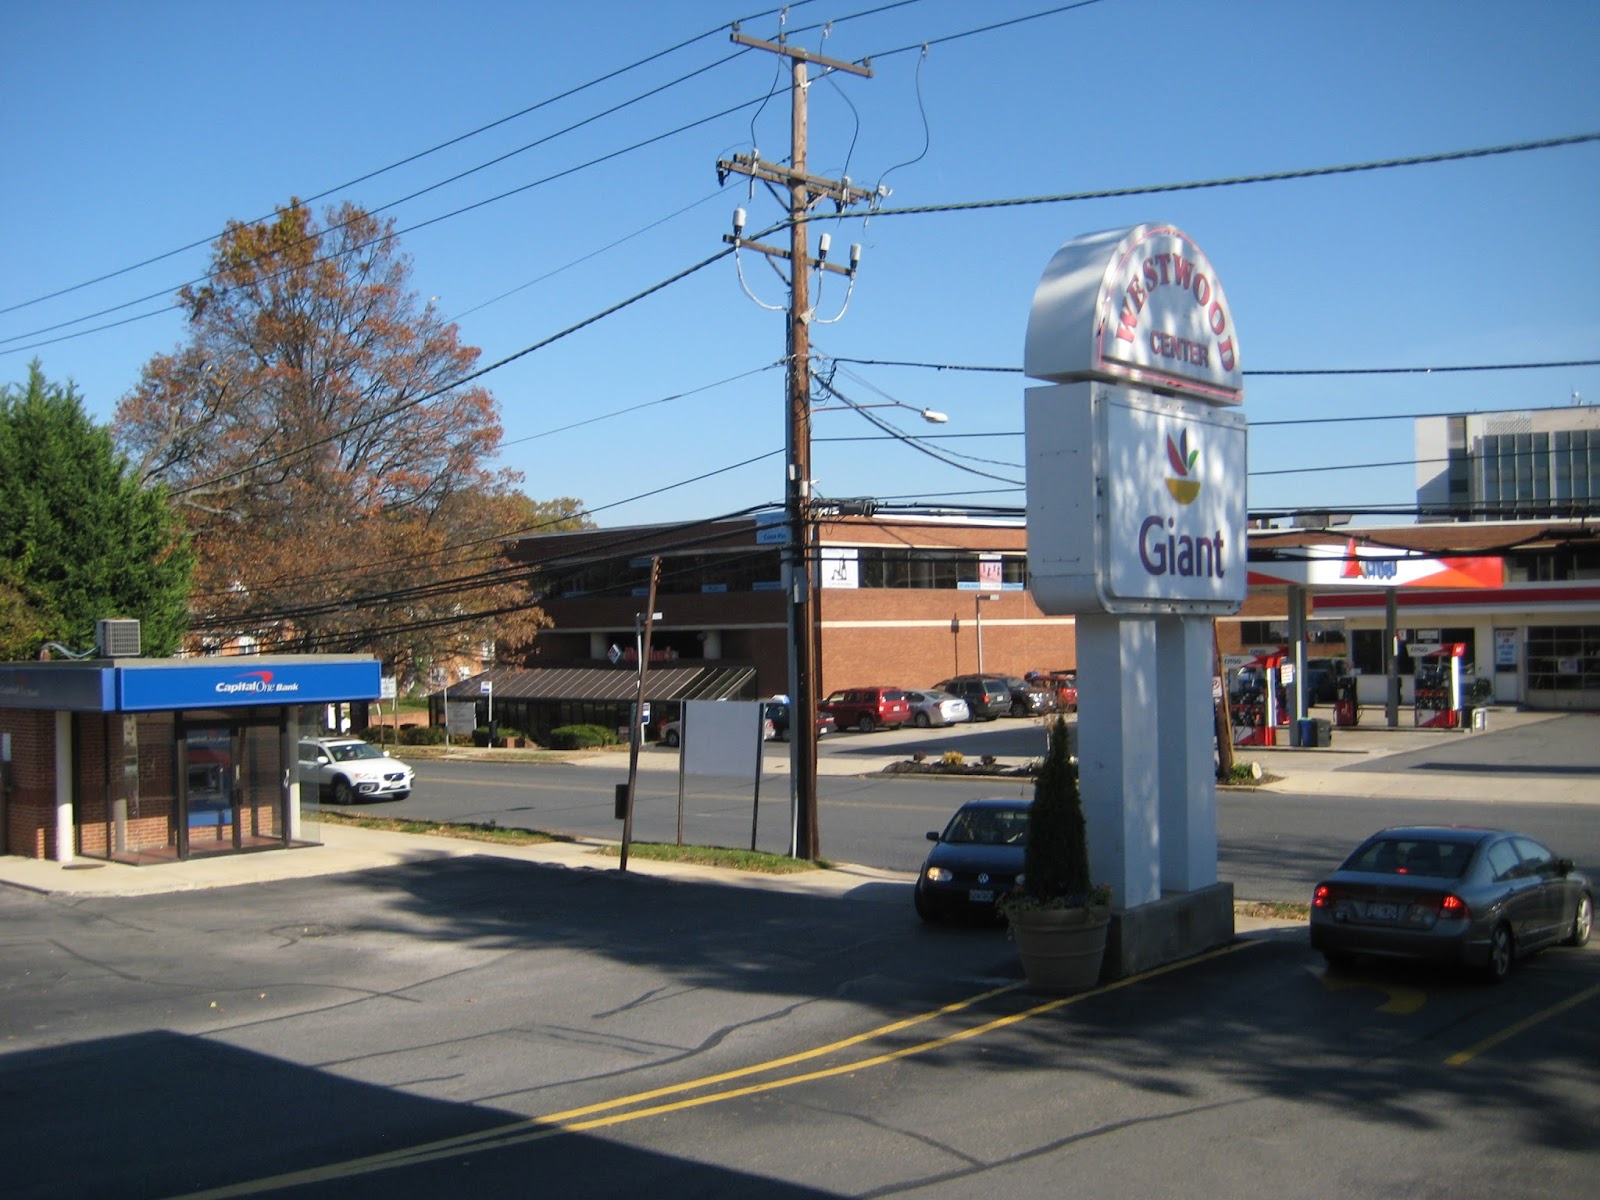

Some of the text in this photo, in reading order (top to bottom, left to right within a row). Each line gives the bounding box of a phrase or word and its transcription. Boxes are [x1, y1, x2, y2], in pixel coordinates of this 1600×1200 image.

[1116, 253, 1235, 371] WESTWOOD
[1150, 330, 1209, 367] CENTER
[1139, 515, 1225, 579] Giant
[276, 682, 299, 692] Bank
